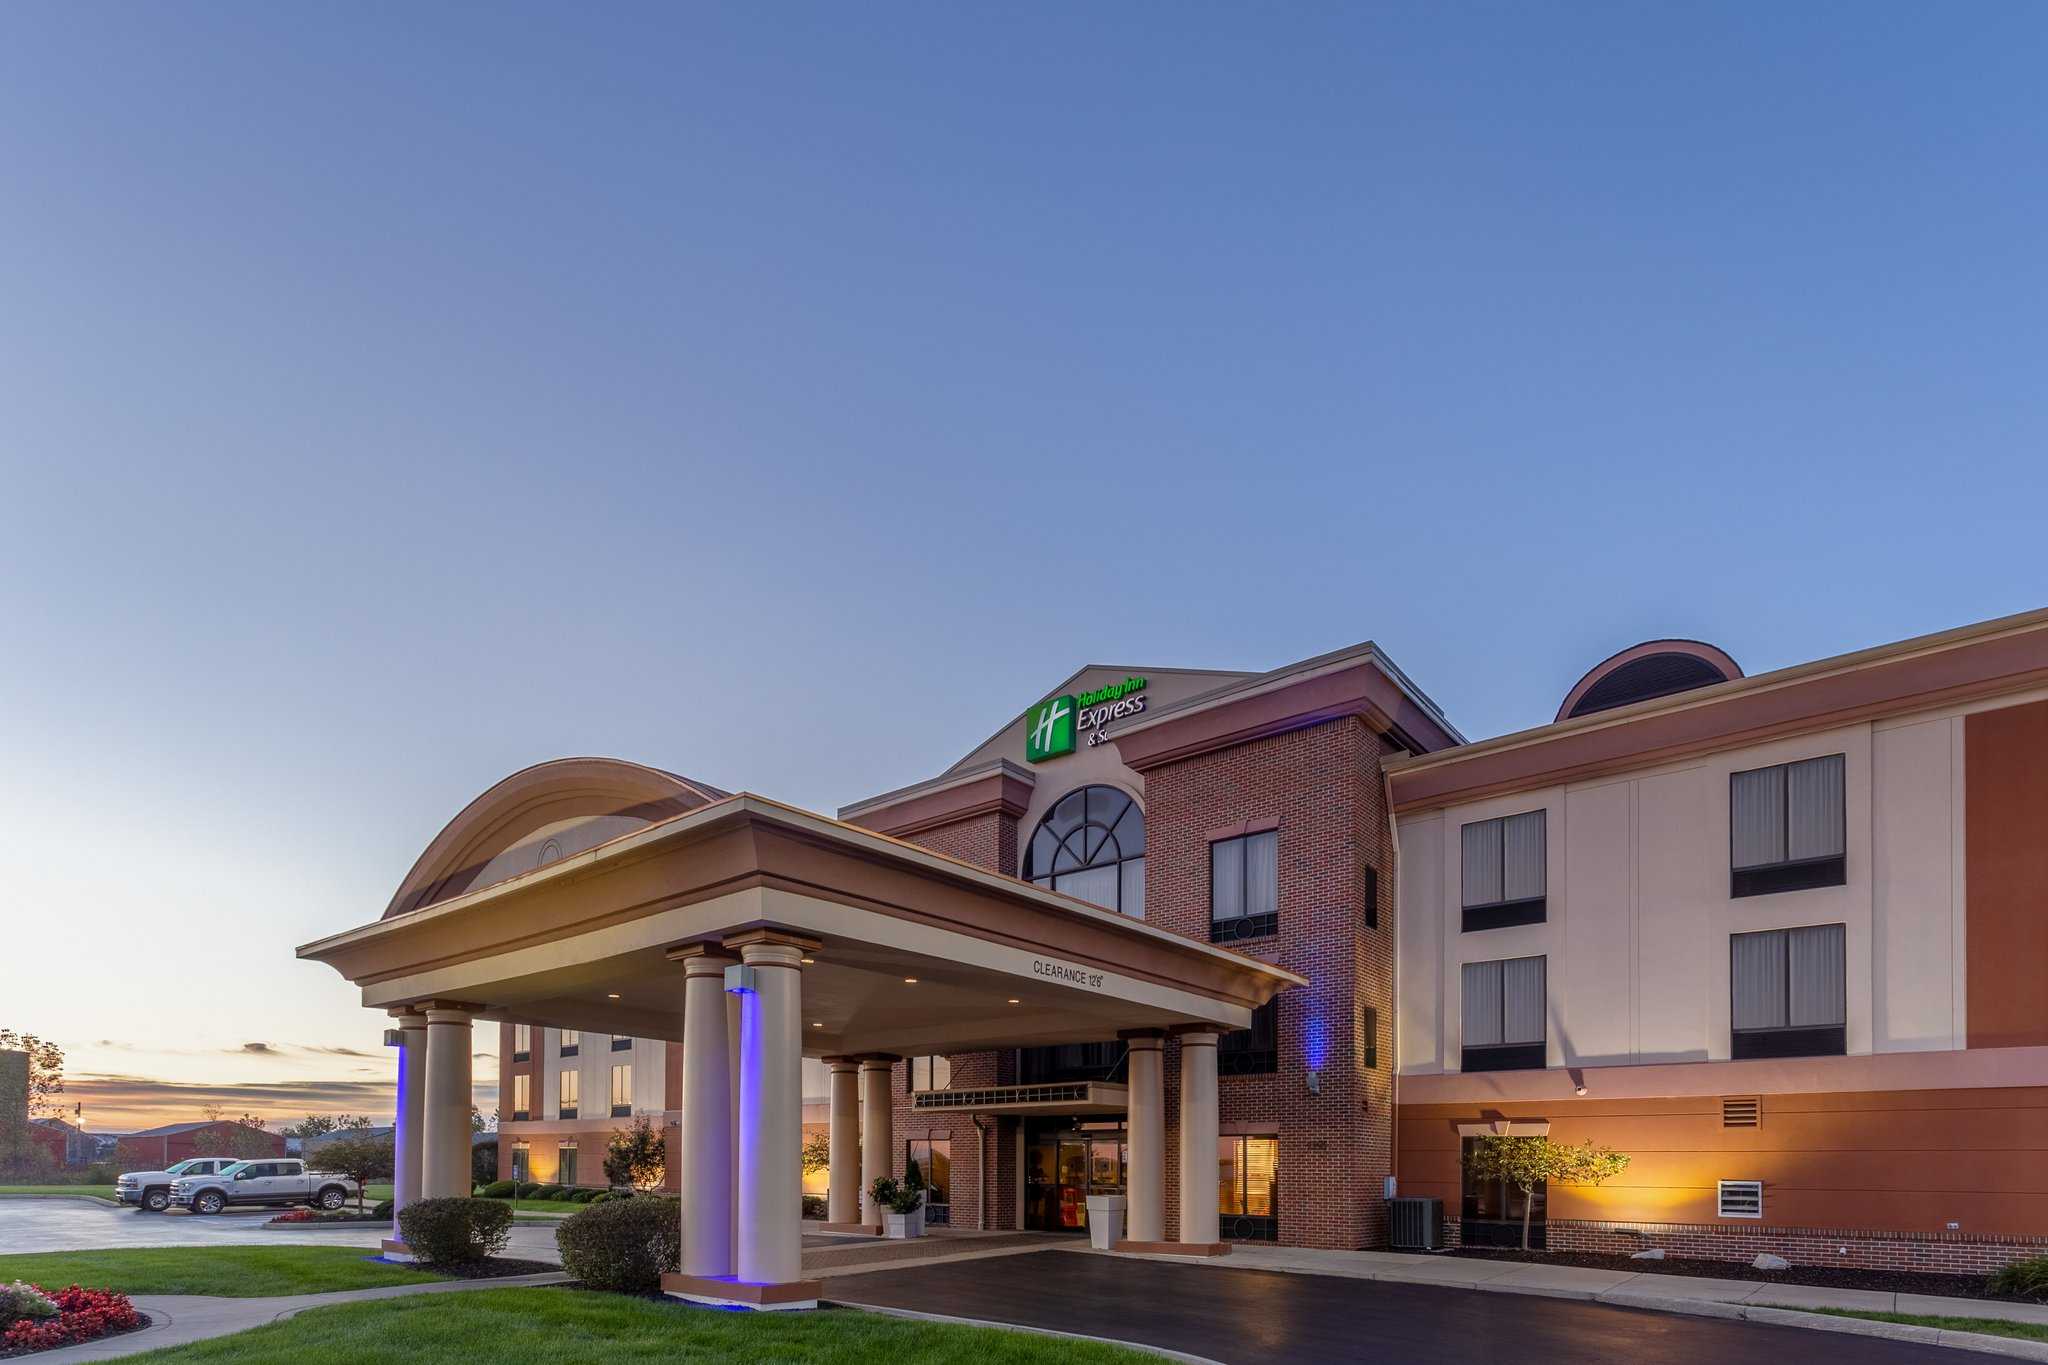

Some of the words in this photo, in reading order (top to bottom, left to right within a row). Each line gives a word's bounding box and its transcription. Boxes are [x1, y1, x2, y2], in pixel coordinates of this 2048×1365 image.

[1079, 684, 1123, 707] Holiday
[1123, 677, 1146, 693] Inn
[1077, 695, 1144, 730] Express
[1087, 733, 1096, 746] &
[1033, 960, 1086, 984] CLEARANCE
